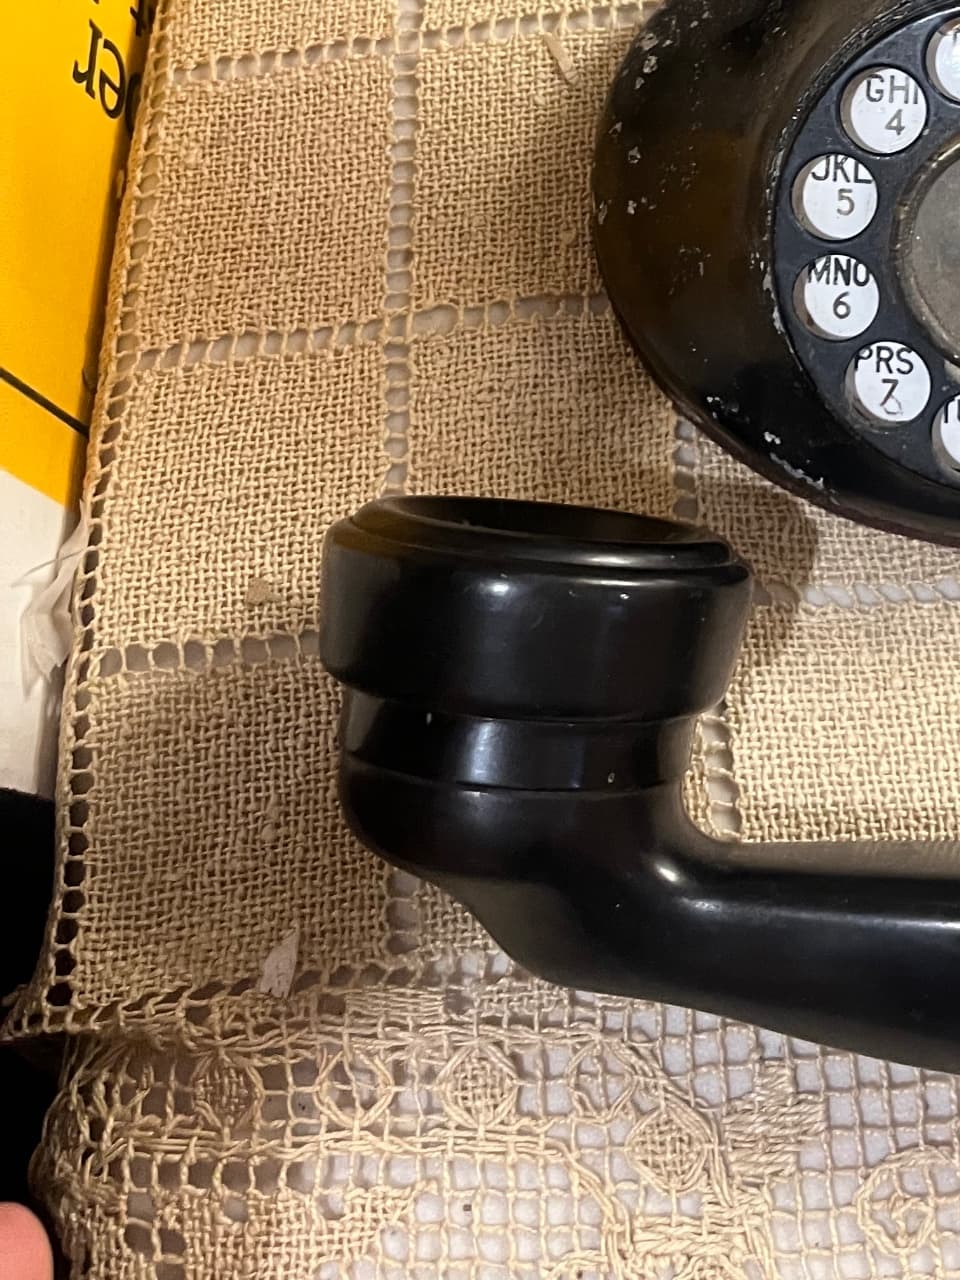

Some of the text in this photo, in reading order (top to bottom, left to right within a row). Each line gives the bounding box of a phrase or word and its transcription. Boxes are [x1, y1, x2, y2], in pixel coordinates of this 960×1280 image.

[865, 74, 919, 105] GHI
[884, 108, 906, 136] 4
[811, 153, 873, 185] JKL
[836, 188, 855, 217] 5
[808, 255, 871, 287] MNO
[833, 291, 851, 320] 6
[853, 345, 915, 375] PRS
[879, 378, 900, 407] 7
